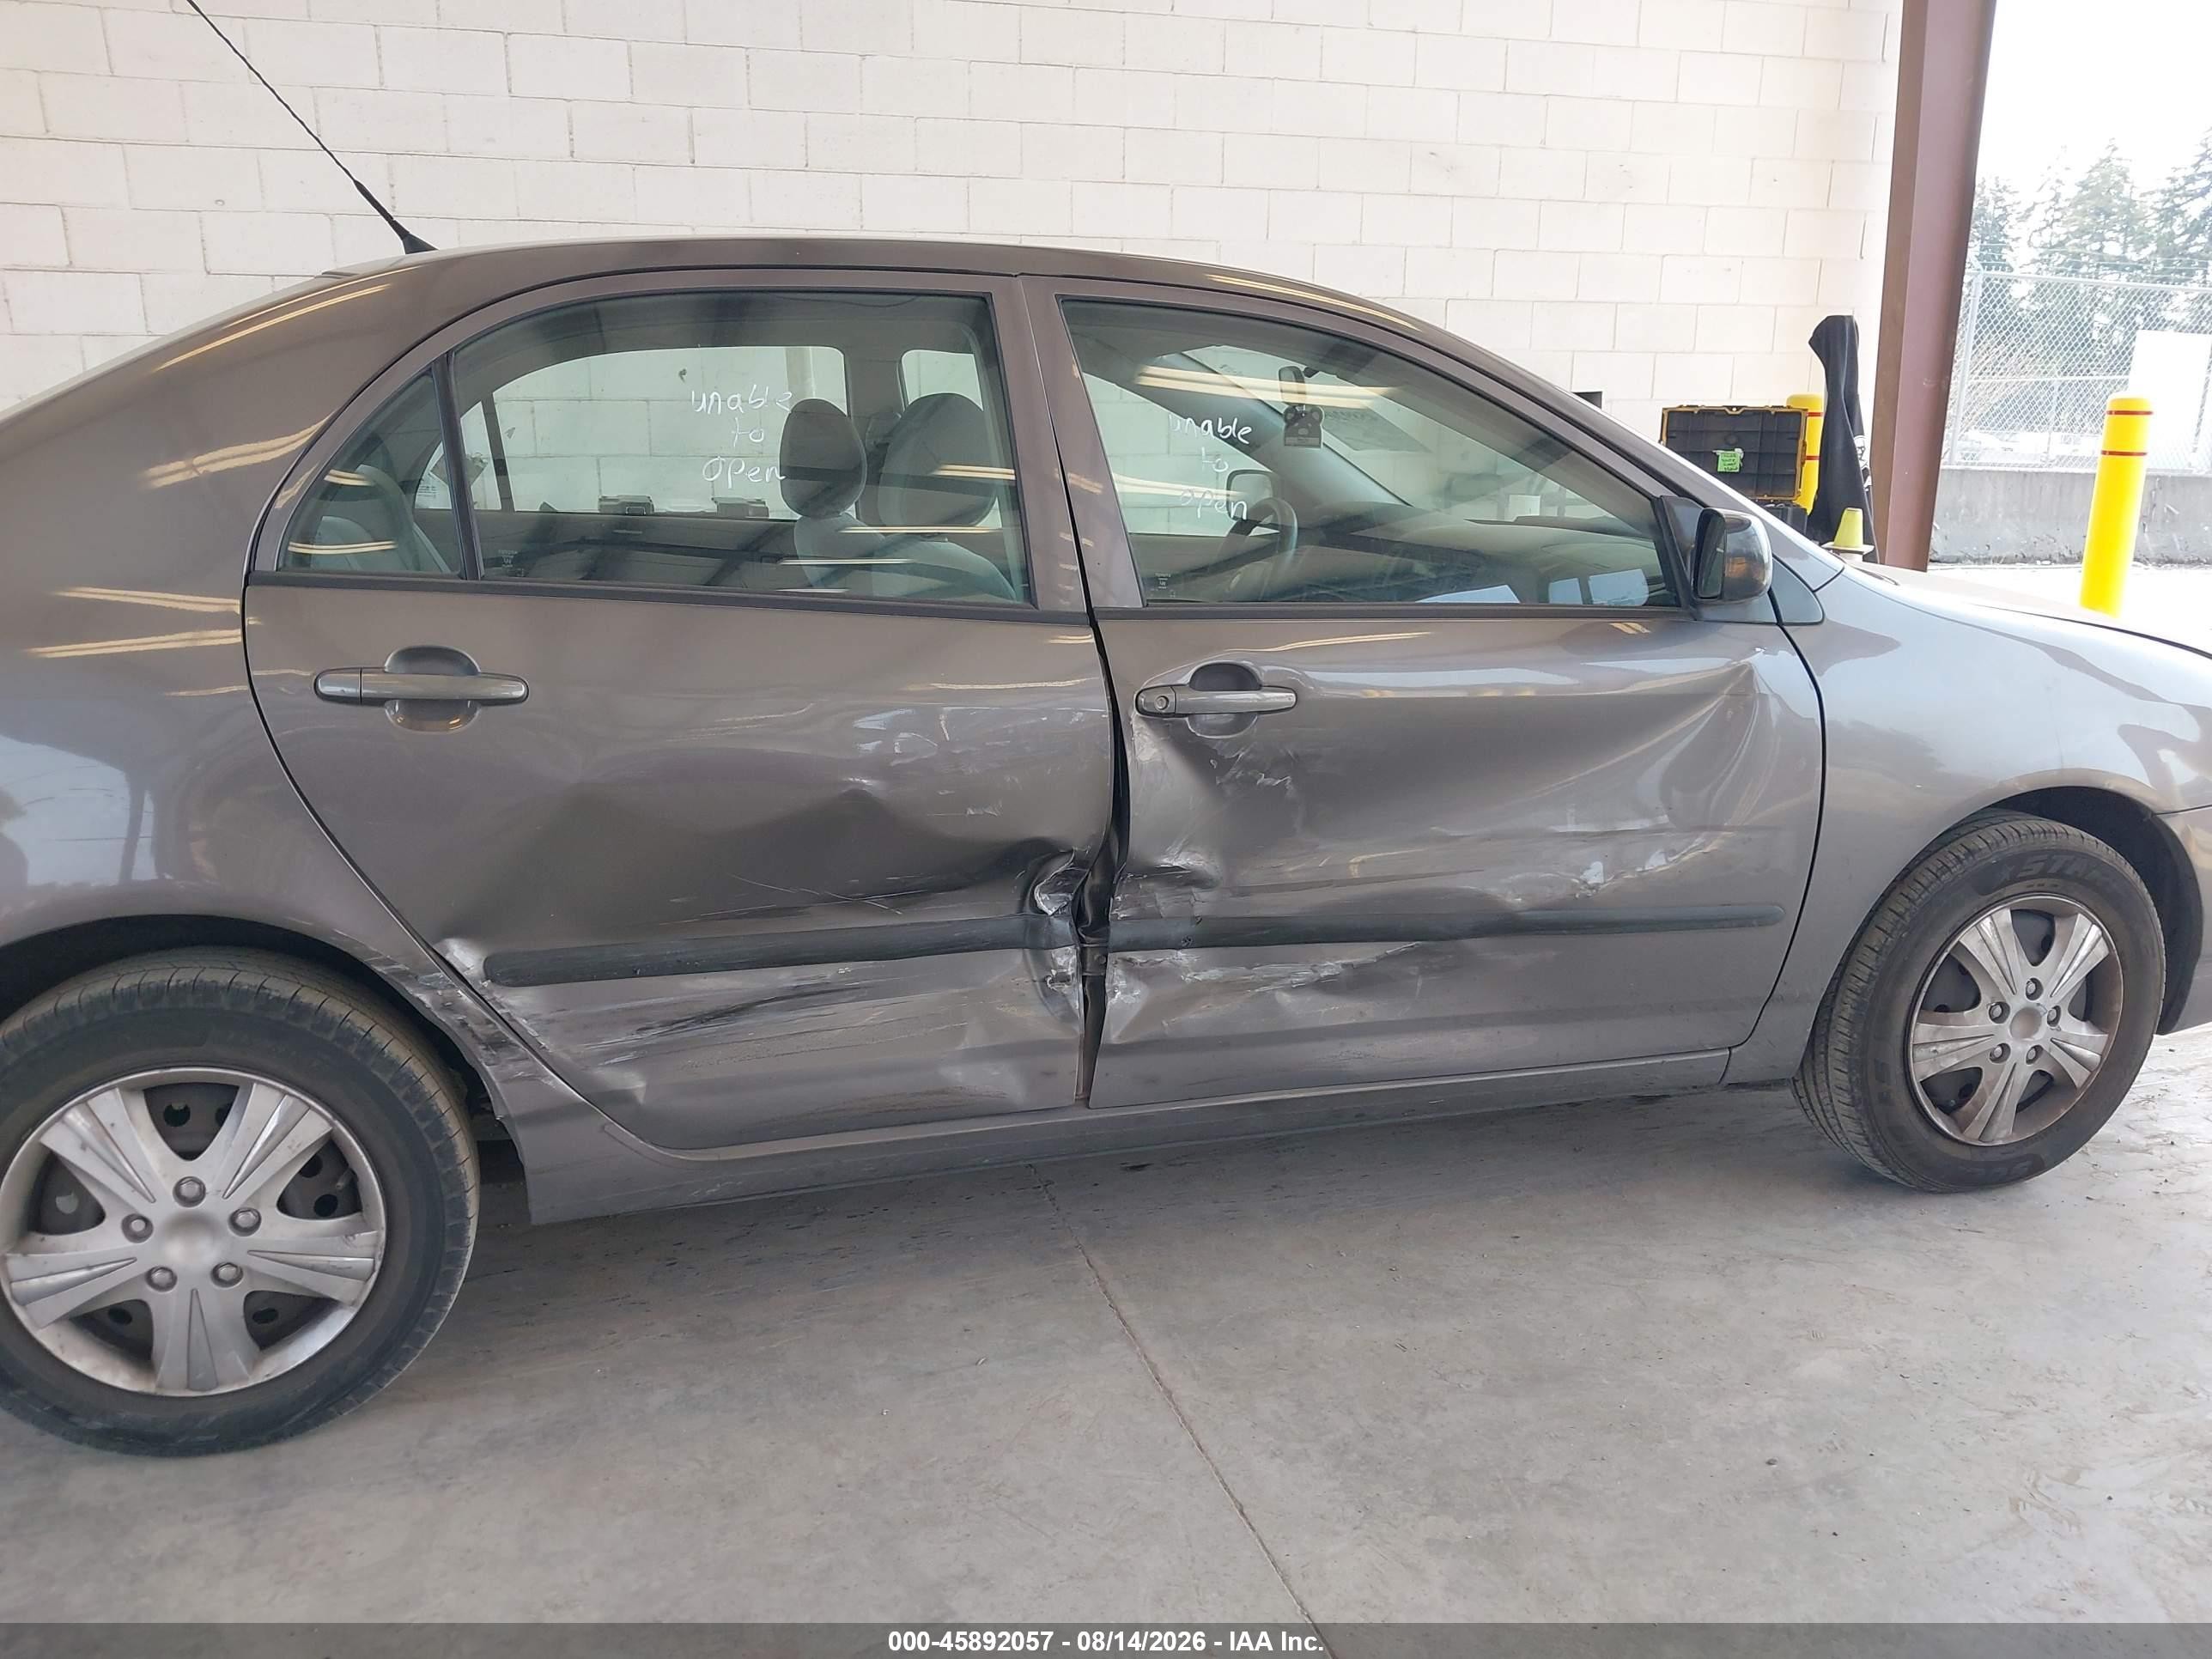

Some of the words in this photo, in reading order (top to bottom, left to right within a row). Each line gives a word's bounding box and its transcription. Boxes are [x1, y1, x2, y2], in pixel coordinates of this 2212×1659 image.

[691, 384, 793, 413] unable
[731, 417, 764, 447] to
[1169, 414, 1252, 444] unable
[1201, 447, 1229, 472] to
